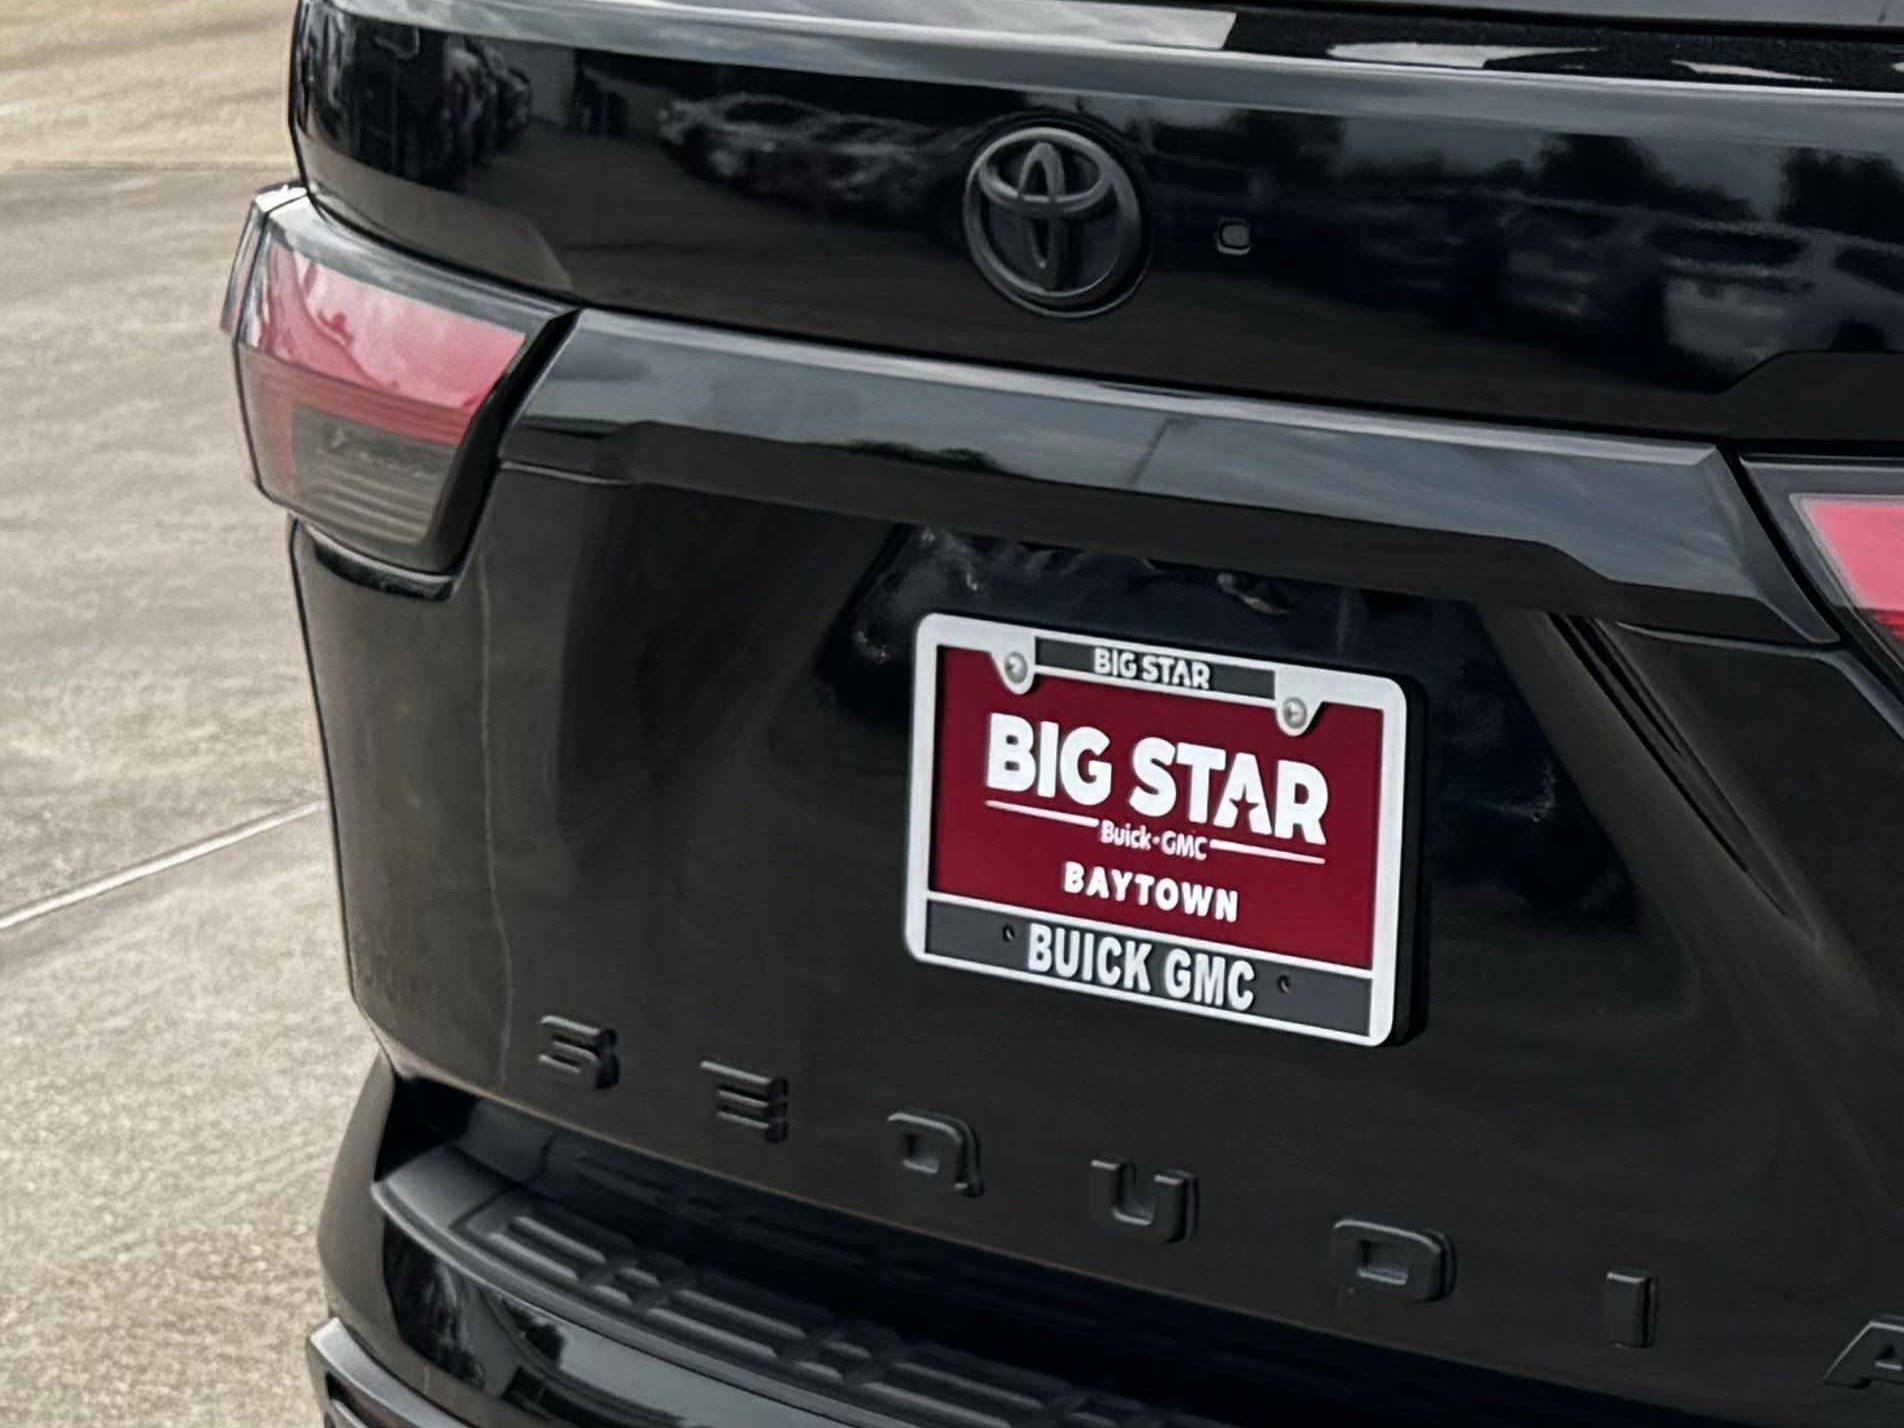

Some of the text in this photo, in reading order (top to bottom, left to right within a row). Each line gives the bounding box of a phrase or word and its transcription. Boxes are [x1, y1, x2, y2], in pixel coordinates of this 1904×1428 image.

[1093, 647, 1211, 690] BIG STAR
[985, 712, 1329, 845] BIG STAR
[1063, 861, 1238, 923] BAYTOWN
[1027, 923, 1256, 1011] BUICK GMC
